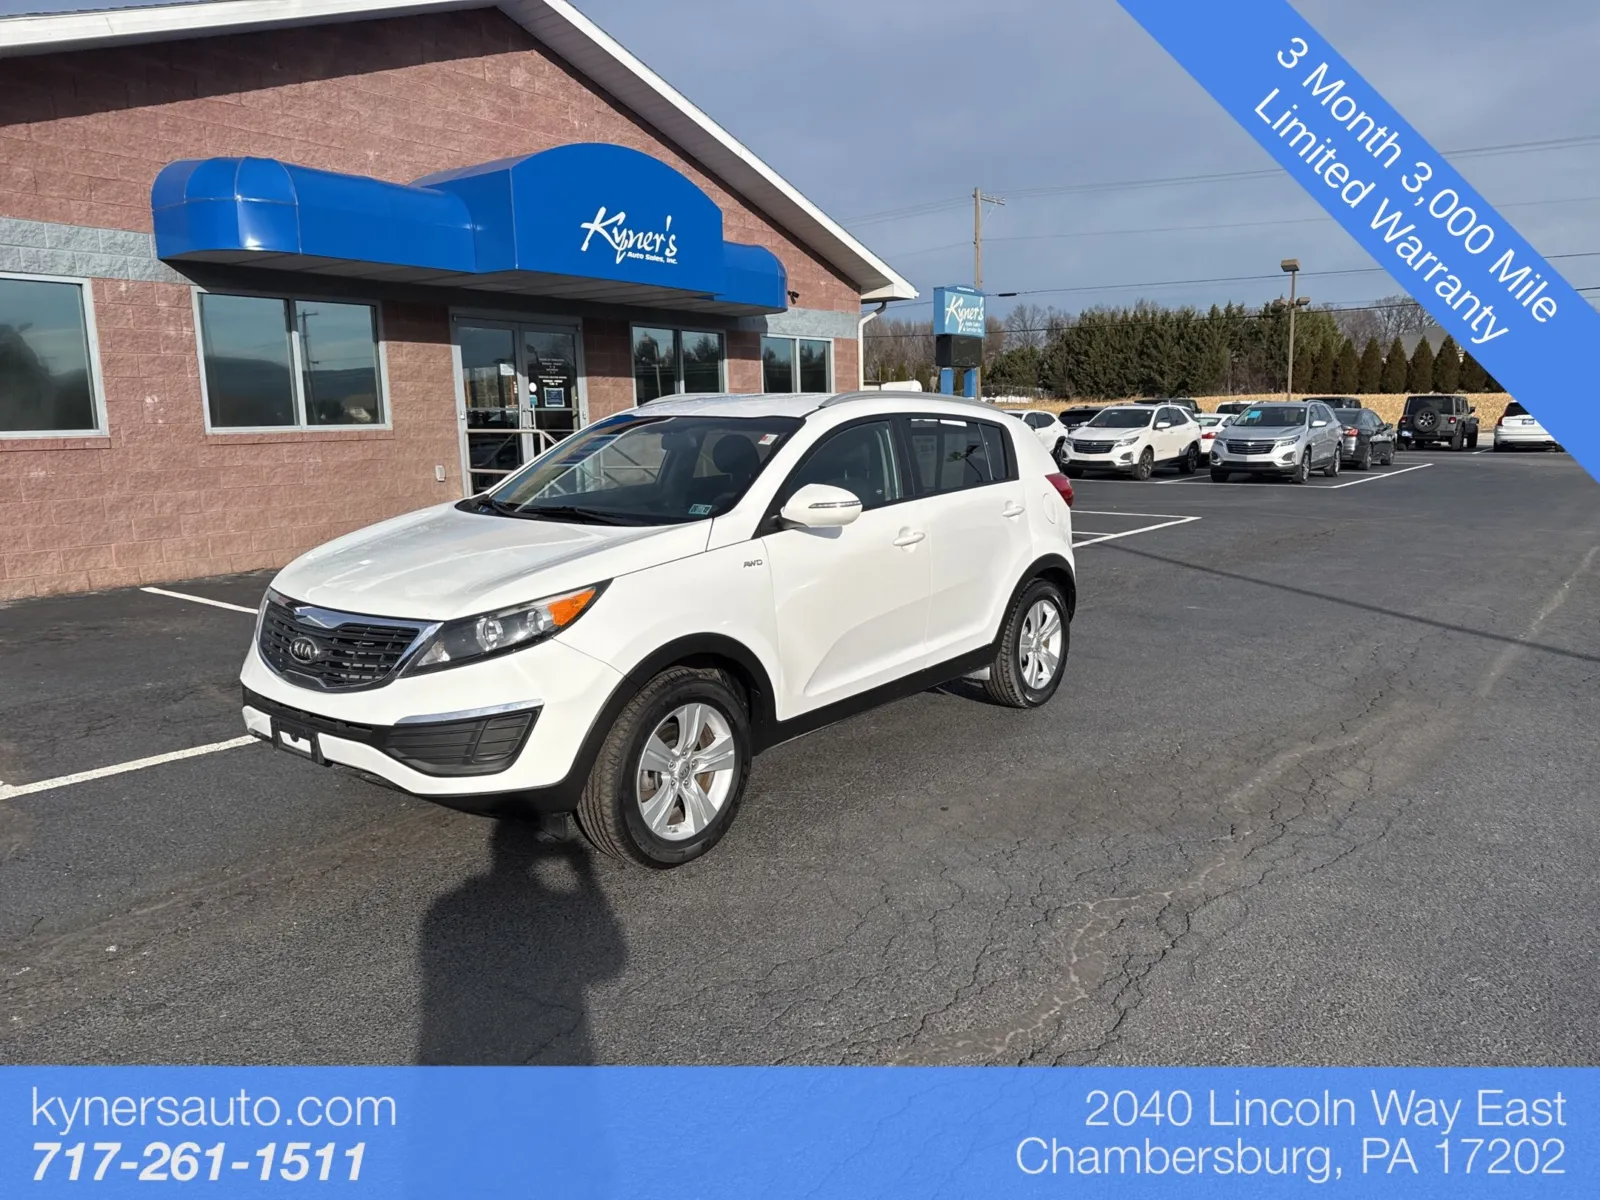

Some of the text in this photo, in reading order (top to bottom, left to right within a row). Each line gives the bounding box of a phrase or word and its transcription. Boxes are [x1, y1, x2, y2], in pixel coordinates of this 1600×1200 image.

[580, 206, 678, 264] Kyner's
[627, 251, 644, 260] Auto
[945, 295, 985, 333] Kyner's
[743, 559, 763, 568] AWD
[294, 641, 312, 658] KIA
